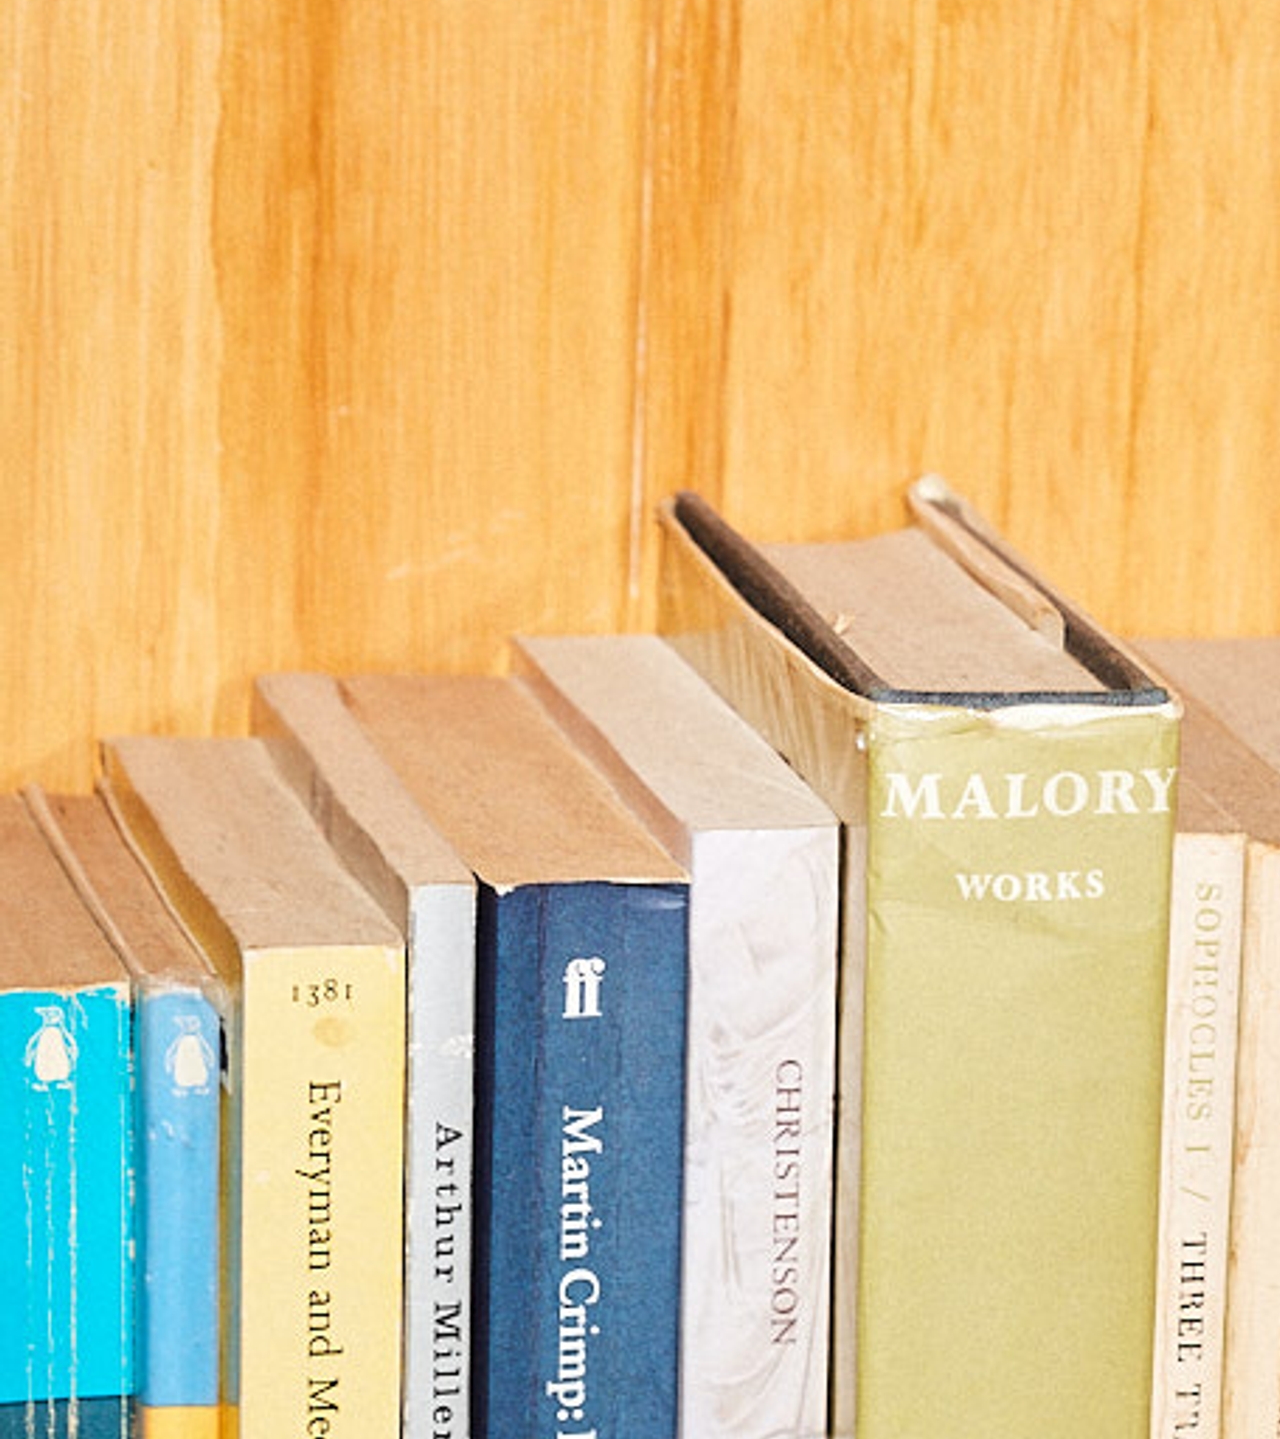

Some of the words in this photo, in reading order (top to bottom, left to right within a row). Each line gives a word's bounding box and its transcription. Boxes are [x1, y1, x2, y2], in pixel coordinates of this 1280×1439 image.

[879, 768, 1178, 821] MALORY
[956, 870, 1105, 902] WORKS
[292, 979, 351, 1007] 1381
[564, 958, 606, 1018] ff
[1185, 883, 1222, 1122] SOPHOCLES
[297, 1081, 342, 1278] Everyman
[433, 1122, 462, 1284] Arthur
[560, 1107, 603, 1257] Martin
[771, 1060, 802, 1345] CHRISTENSON
[307, 1291, 342, 1358] and
[554, 1270, 600, 1421] Crimp:
[1174, 1232, 1208, 1363] THREE
